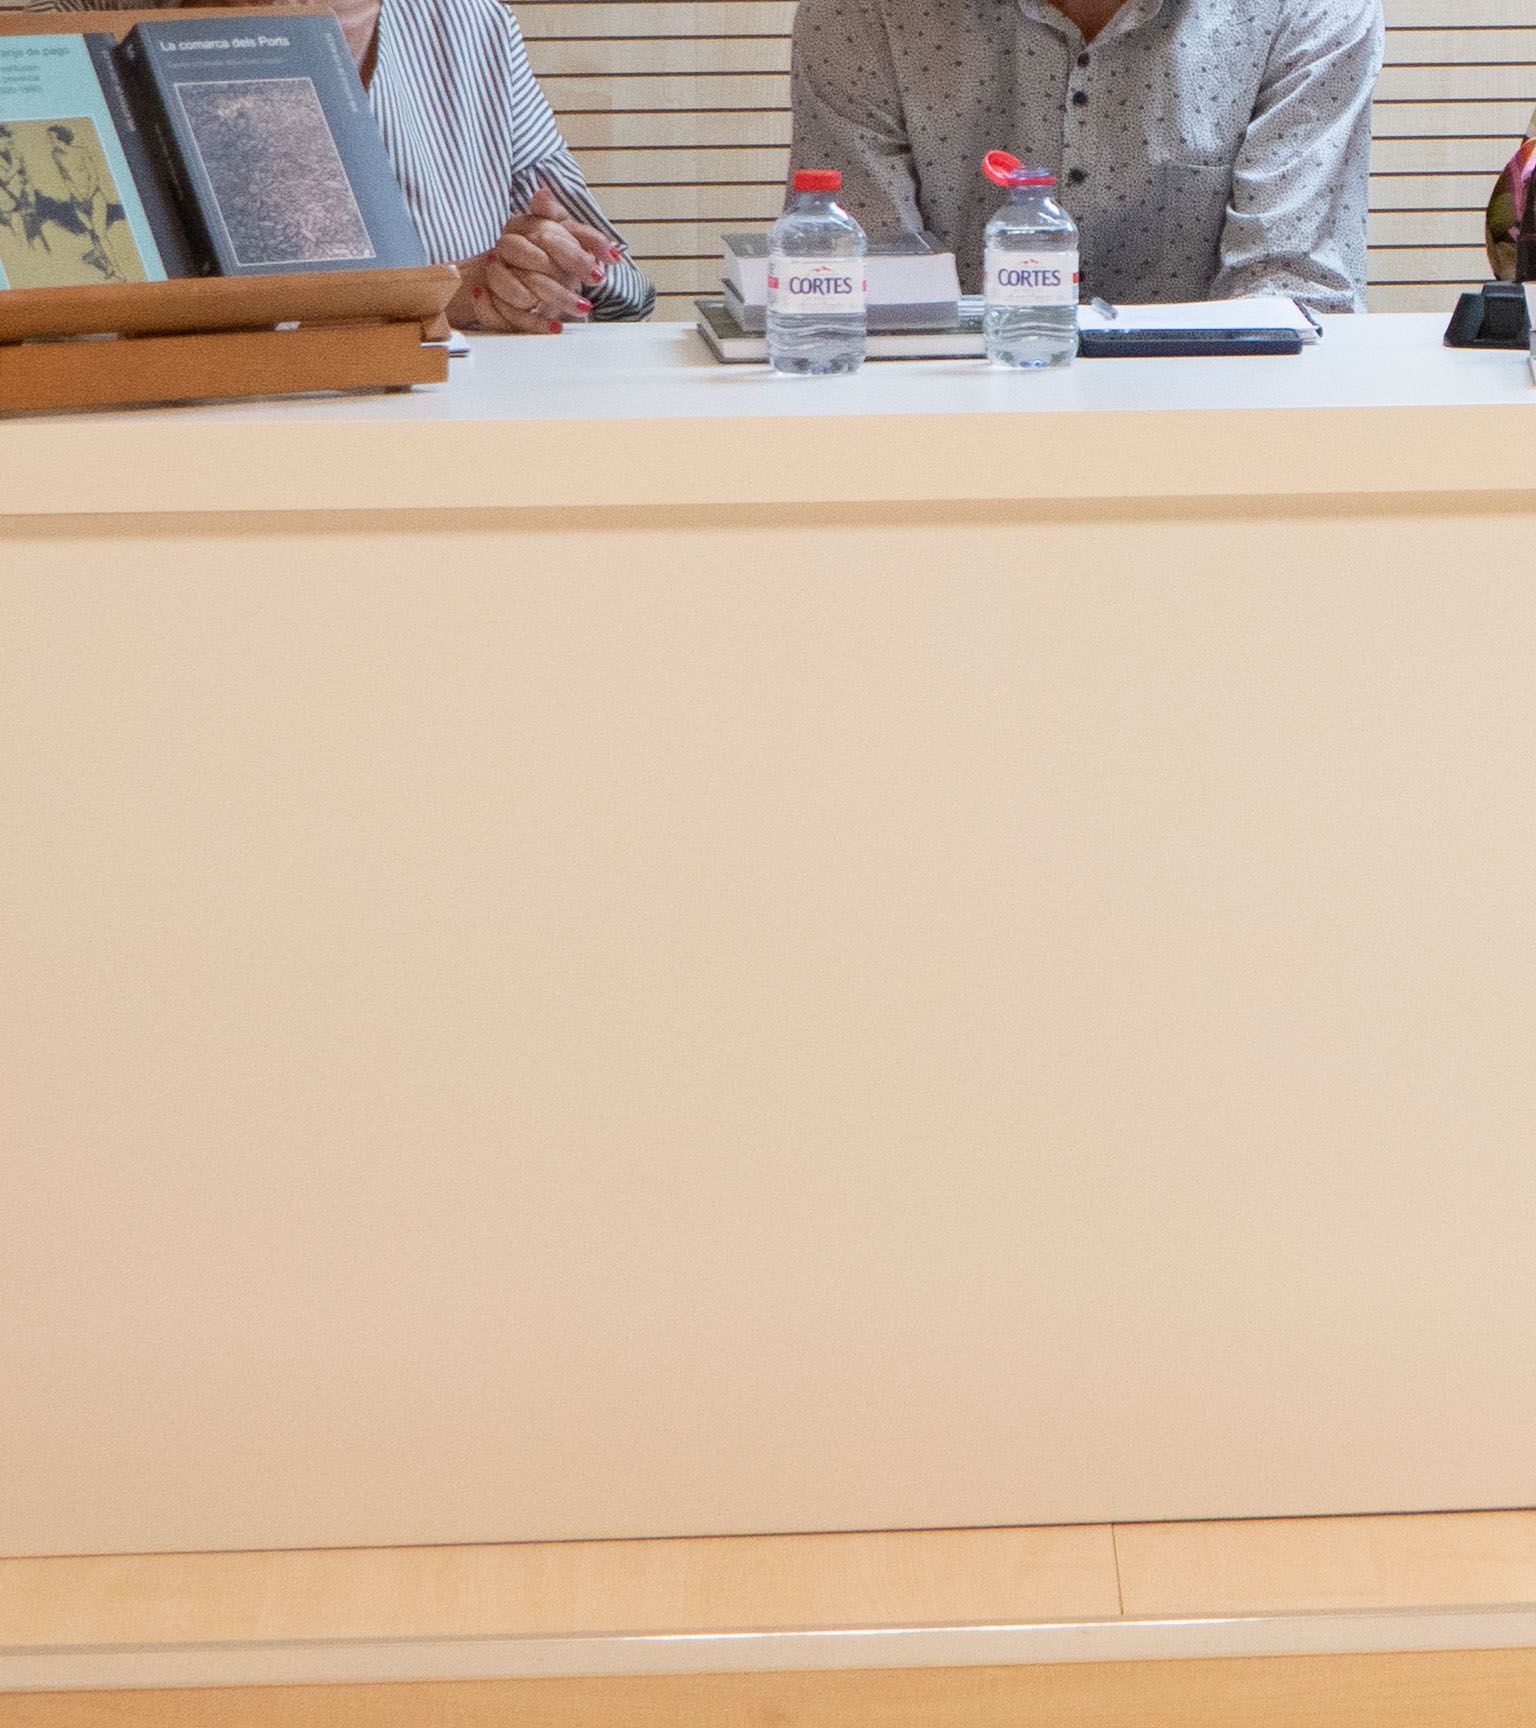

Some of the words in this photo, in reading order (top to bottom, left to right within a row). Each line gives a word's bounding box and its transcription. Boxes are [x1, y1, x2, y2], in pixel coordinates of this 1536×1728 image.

[160, 40, 175, 52] La
[178, 38, 230, 51] comarca
[231, 36, 257, 49] dels
[258, 35, 291, 48] Ports
[789, 276, 853, 295] CORTES
[997, 268, 1062, 288] CORTES
